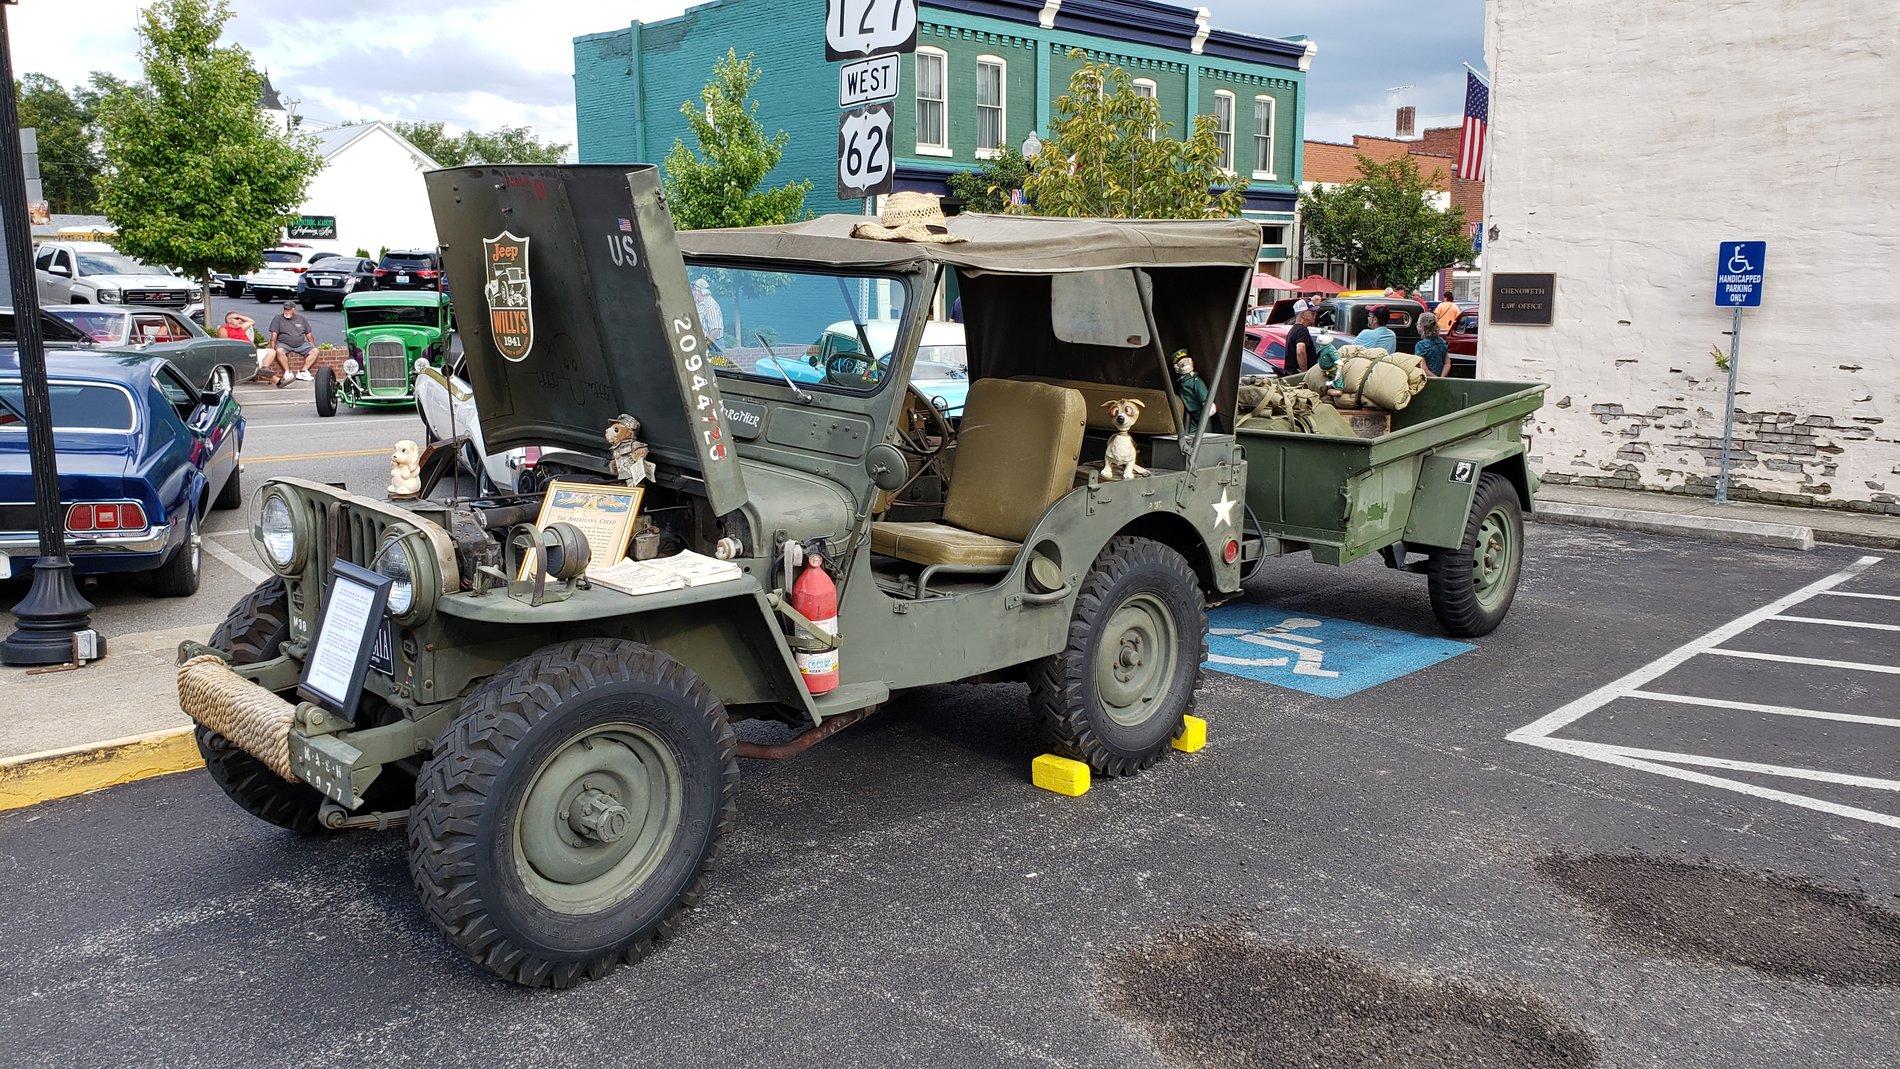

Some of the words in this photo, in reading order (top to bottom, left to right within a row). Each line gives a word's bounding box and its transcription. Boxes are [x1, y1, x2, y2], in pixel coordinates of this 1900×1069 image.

[839, 0, 902, 38] 127
[847, 65, 890, 96] WEST
[846, 125, 883, 177] 62
[492, 243, 519, 261] Jeep
[607, 234, 638, 267] US
[1718, 274, 1762, 283] HANDICAPPED
[1725, 284, 1753, 293] PARKING
[1729, 293, 1747, 302] ONLY
[492, 310, 528, 335] WILLYS
[503, 336, 521, 347] 1941
